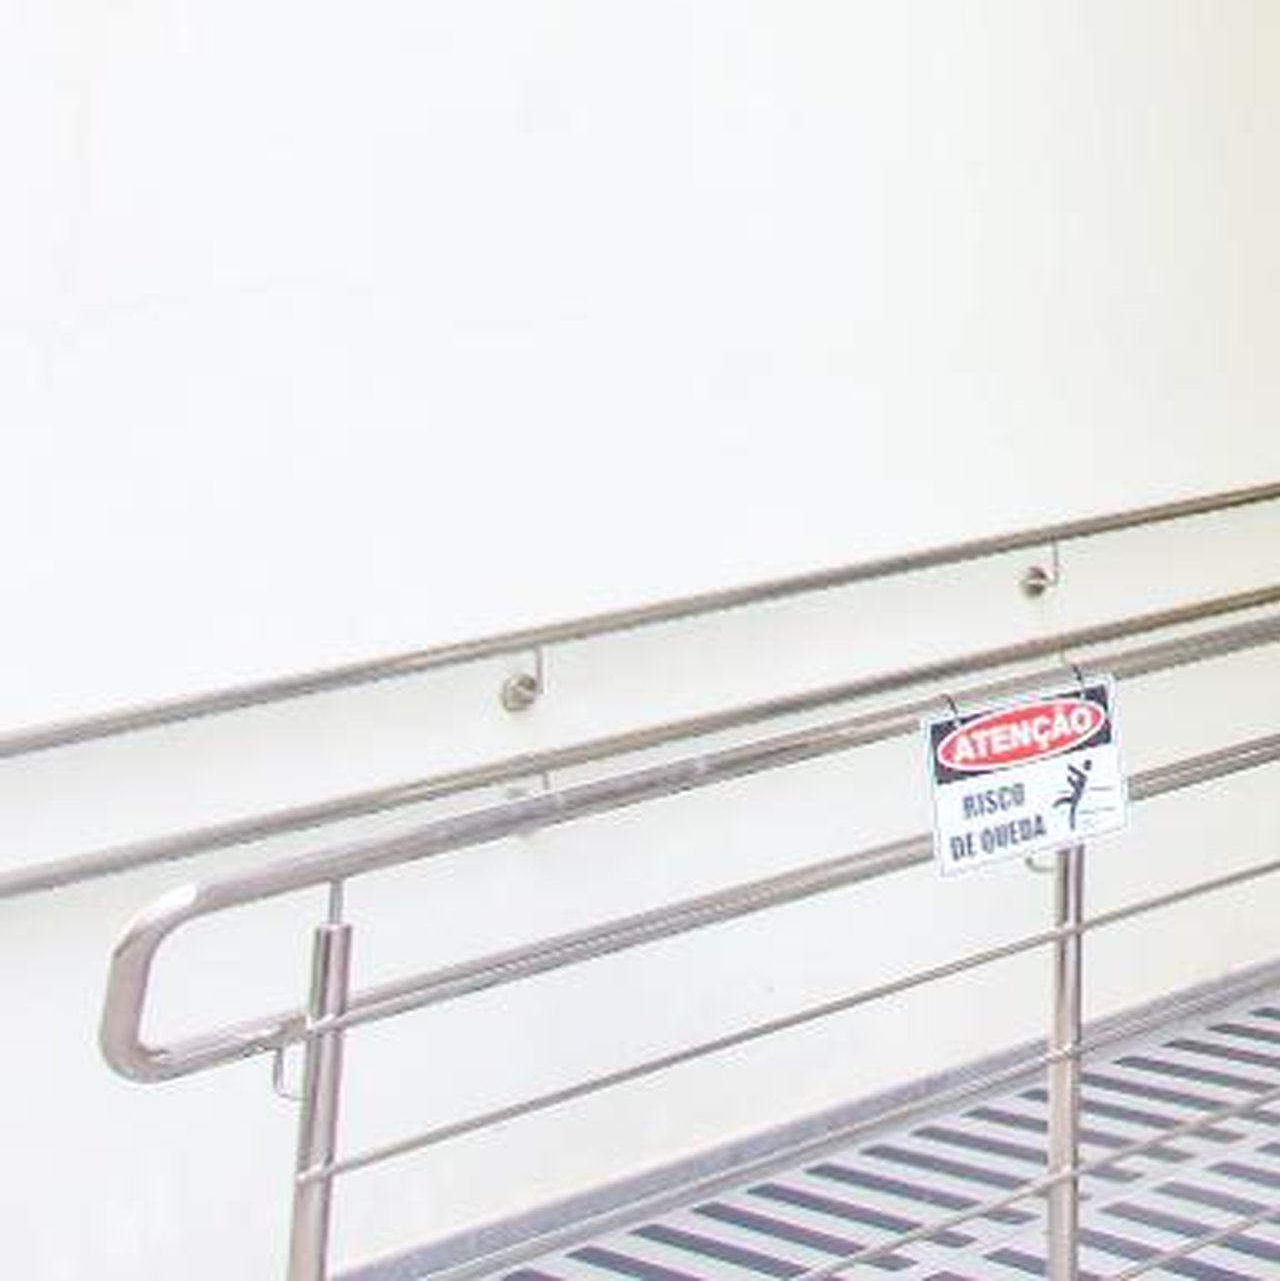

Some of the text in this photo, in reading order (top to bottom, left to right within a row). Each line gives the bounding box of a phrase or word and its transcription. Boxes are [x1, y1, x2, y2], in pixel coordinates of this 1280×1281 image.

[953, 704, 1092, 763] ATENÇÃO
[962, 782, 1026, 820] RISCO
[949, 815, 1047, 862] DE QUEDA
